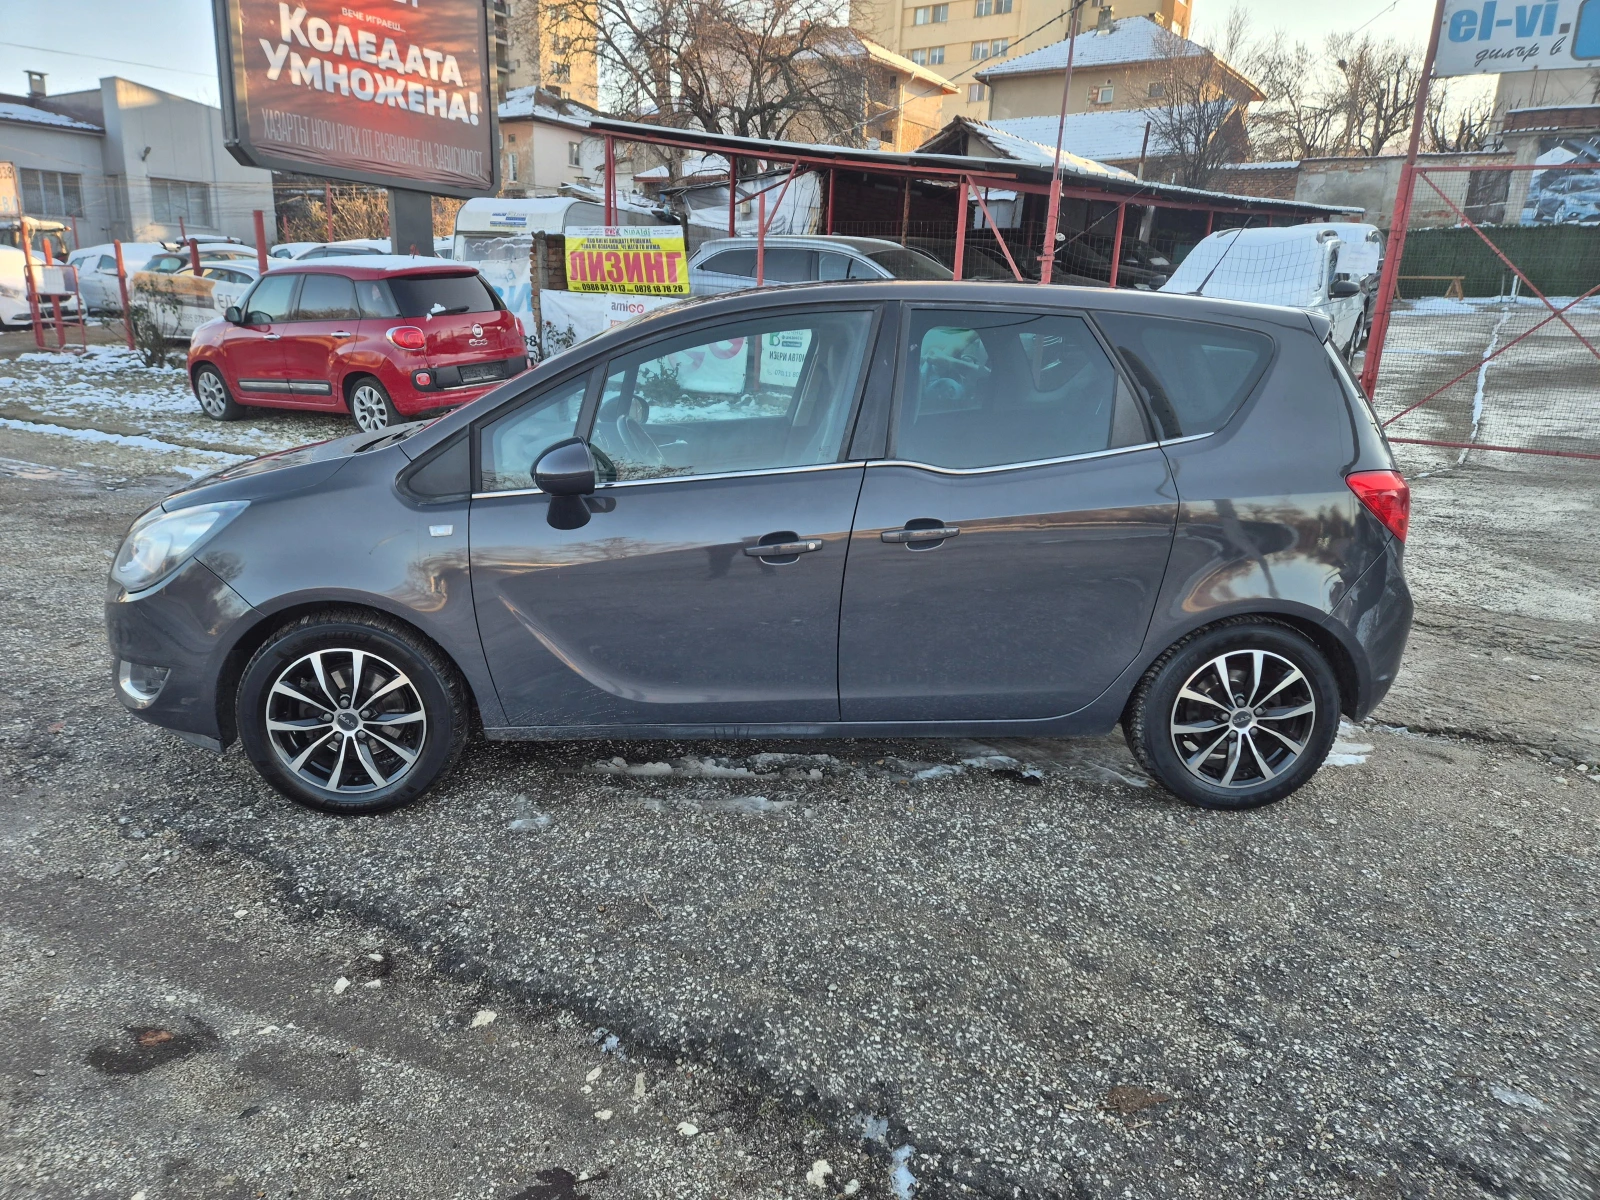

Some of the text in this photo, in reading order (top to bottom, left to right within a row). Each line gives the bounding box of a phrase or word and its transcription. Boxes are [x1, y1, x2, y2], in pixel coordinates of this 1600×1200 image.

[341, 7, 364, 22] ВЕЧЕ
[279, 2, 467, 87] КОЛЕДАТА
[1474, 43, 1540, 67] дилър
[259, 38, 479, 126] УМНОЖЕНА!
[261, 107, 310, 147] ХАЗАРТЪТ
[311, 118, 337, 151] НОСИ
[337, 123, 361, 156] РИСК
[362, 128, 374, 158] ОТ
[374, 131, 421, 167] РАЗВИВАНЕ
[421, 140, 434, 168] НА
[569, 251, 682, 284] ЛИЗИНГ
[610, 284, 617, 292] 31
[618, 284, 626, 292] 13
[673, 285, 683, 293] 28
